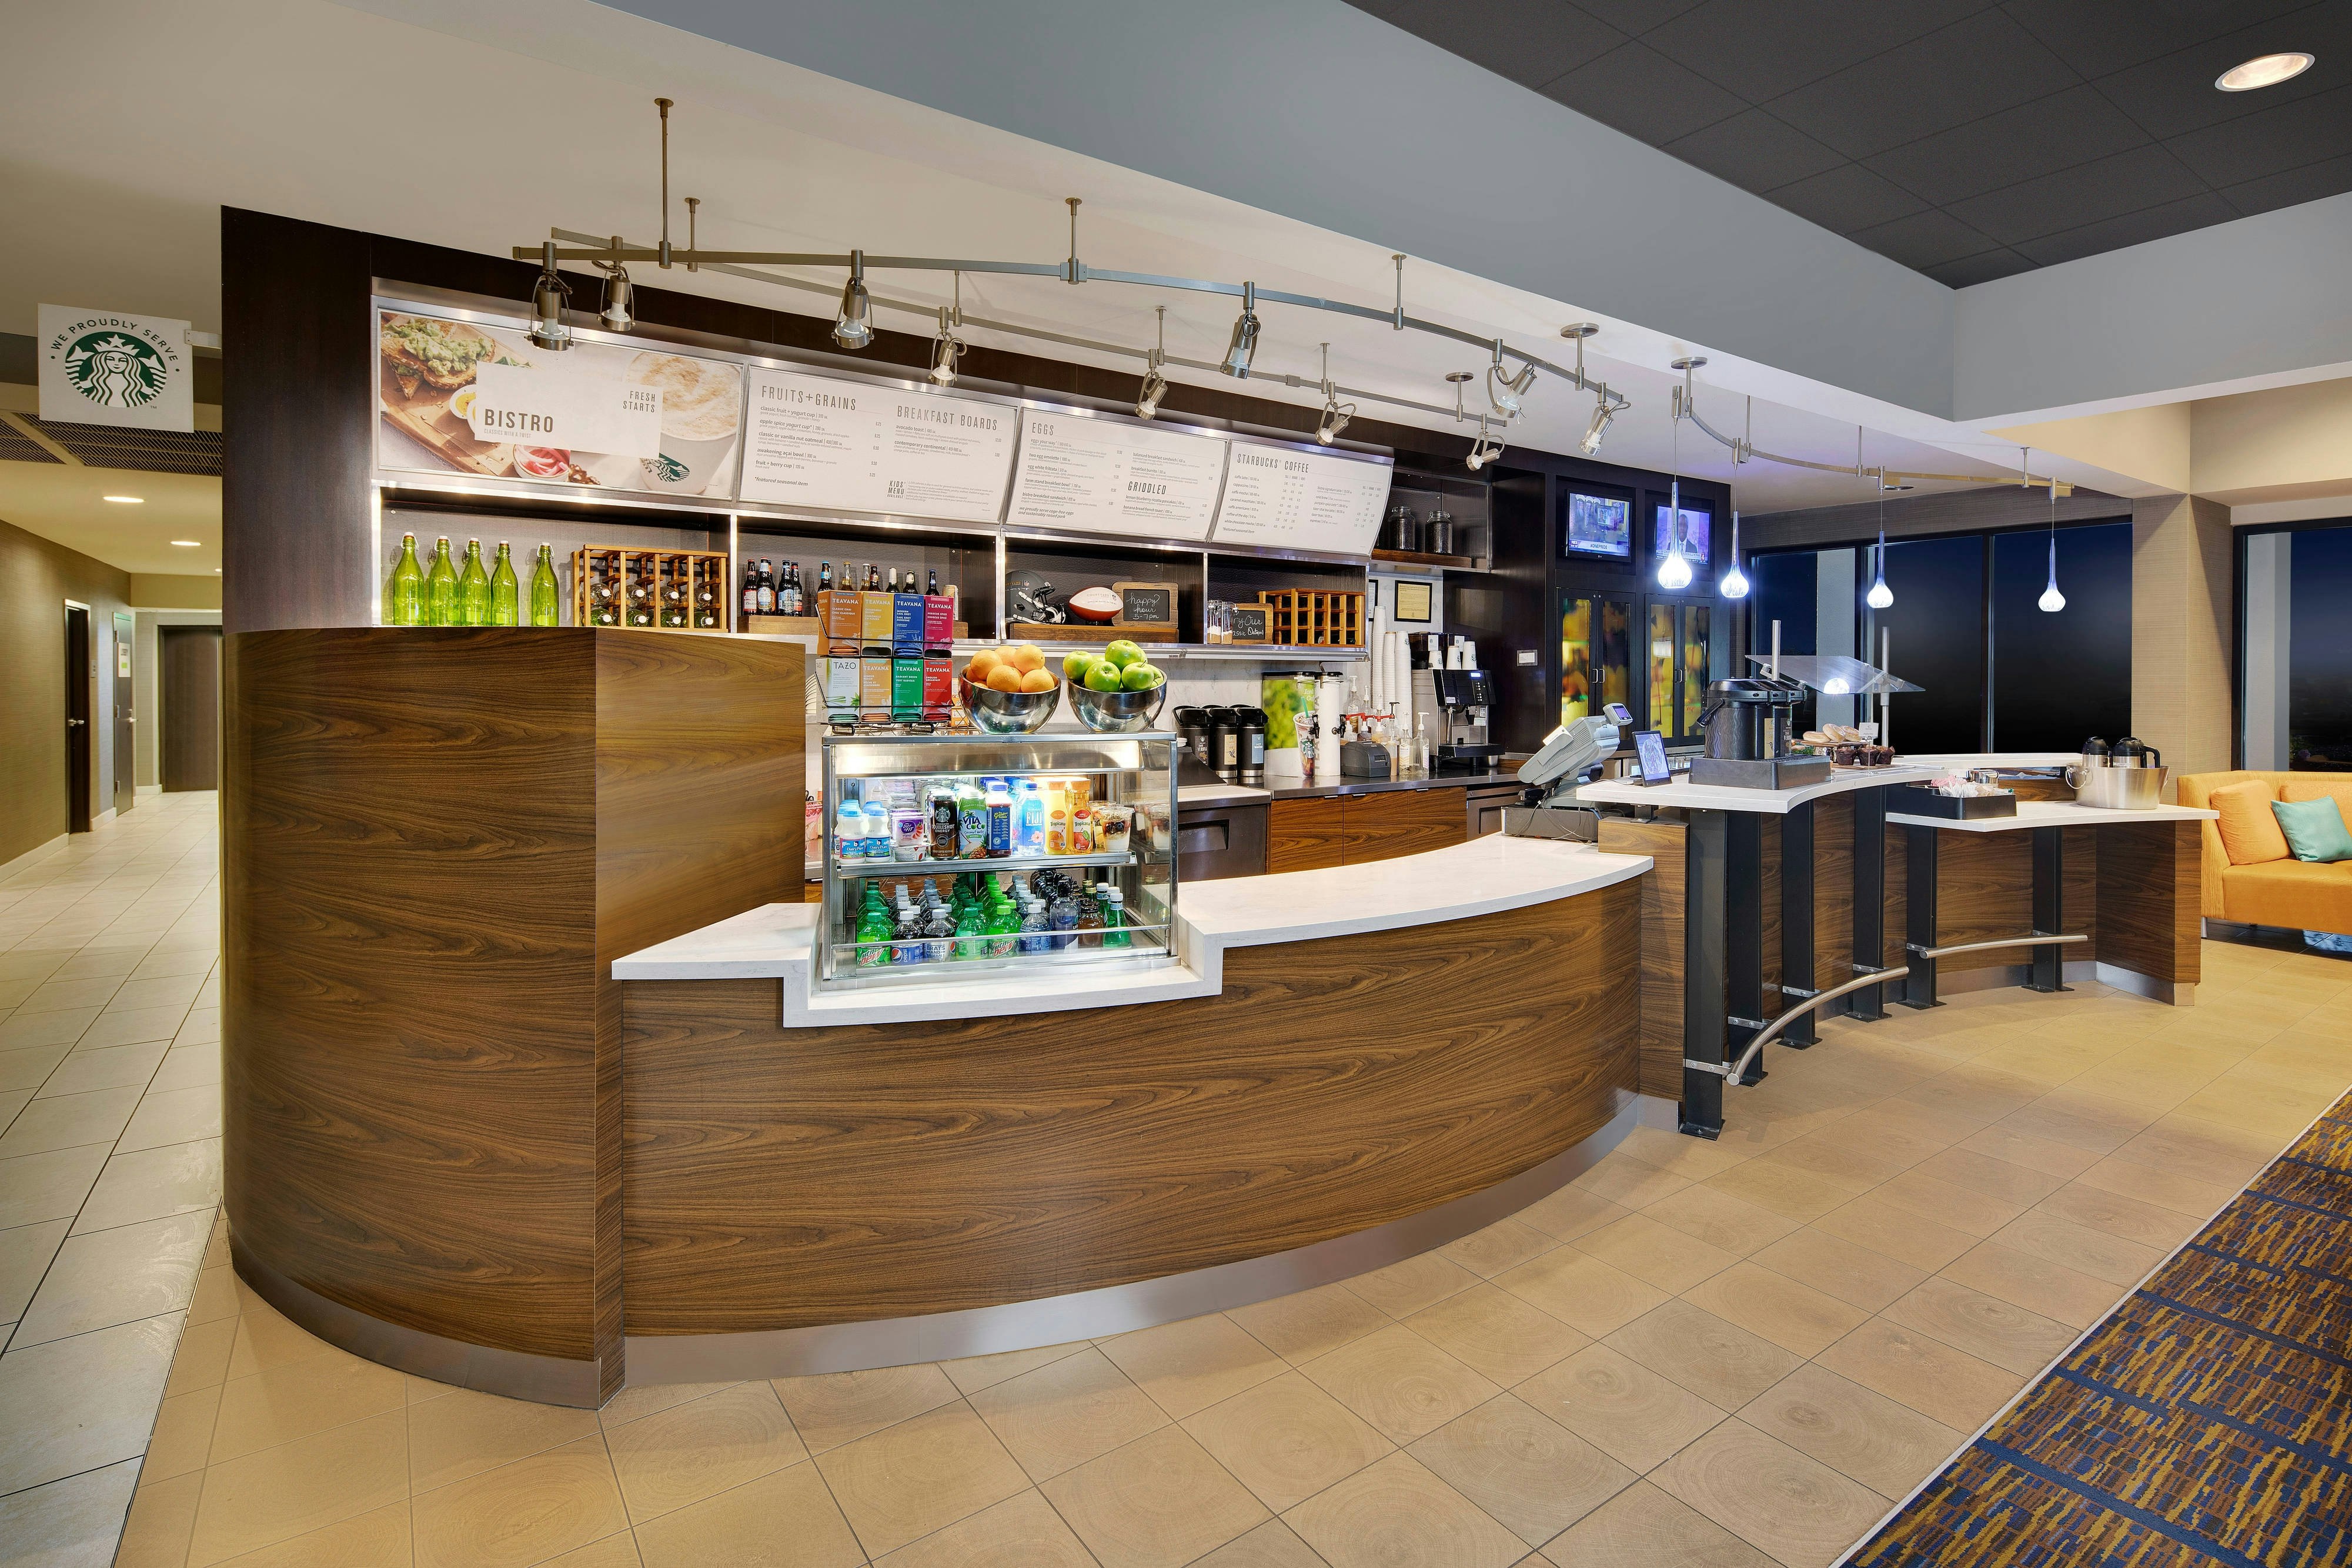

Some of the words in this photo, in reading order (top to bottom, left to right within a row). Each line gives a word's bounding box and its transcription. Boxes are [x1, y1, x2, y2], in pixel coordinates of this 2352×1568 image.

[51, 334, 68, 350] WE
[68, 319, 138, 334] PROUDLY
[143, 329, 179, 362] SERVE
[630, 390, 655, 402] FRESH
[761, 385, 857, 411] FRUITS+GRAINS
[623, 400, 655, 413] STARTS
[485, 409, 553, 433] BISTRO
[897, 405, 954, 424] BREAKFAST
[961, 414, 997, 431] BOARDS
[1032, 422, 1054, 436] EGGS
[894, 440, 923, 449] contemporary
[1237, 453, 1278, 469] STARBUCKS
[1284, 460, 1309, 473] COFFEE
[888, 487, 904, 495] MENU
[1128, 481, 1167, 495] GRIDDLED
[1126, 592, 1160, 609] happy
[1134, 604, 1157, 613] hour
[1245, 615, 1263, 626] Our
[962, 816, 981, 824] VITA
[1026, 811, 1042, 824] FIJI
